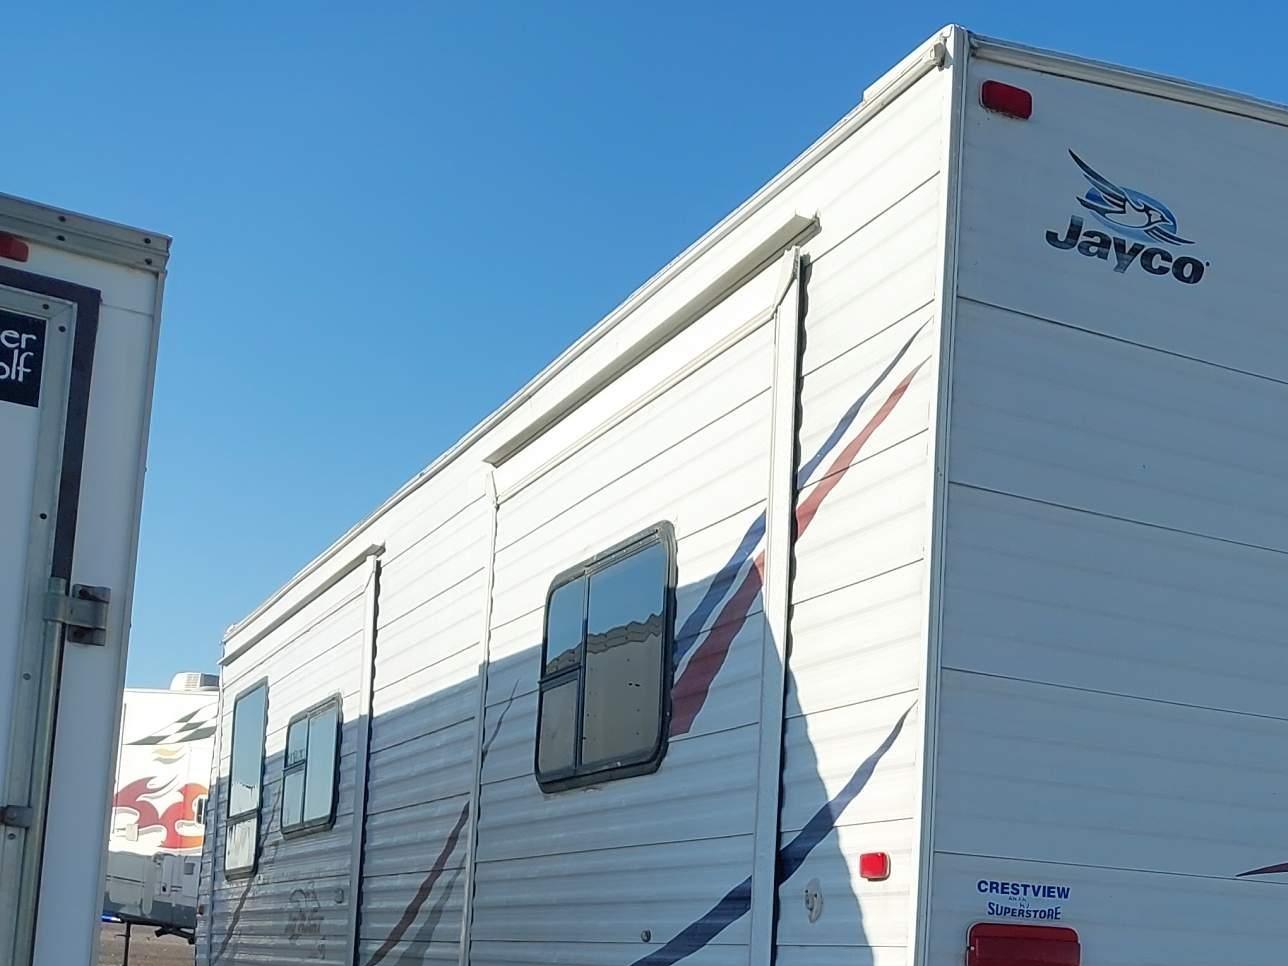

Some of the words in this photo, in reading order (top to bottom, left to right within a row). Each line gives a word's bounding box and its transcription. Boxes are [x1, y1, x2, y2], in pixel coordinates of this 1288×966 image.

[1045, 214, 1206, 285] Jayco
[976, 879, 1071, 900] CRESTVIEW
[987, 901, 1062, 920] SUPERSTORE
